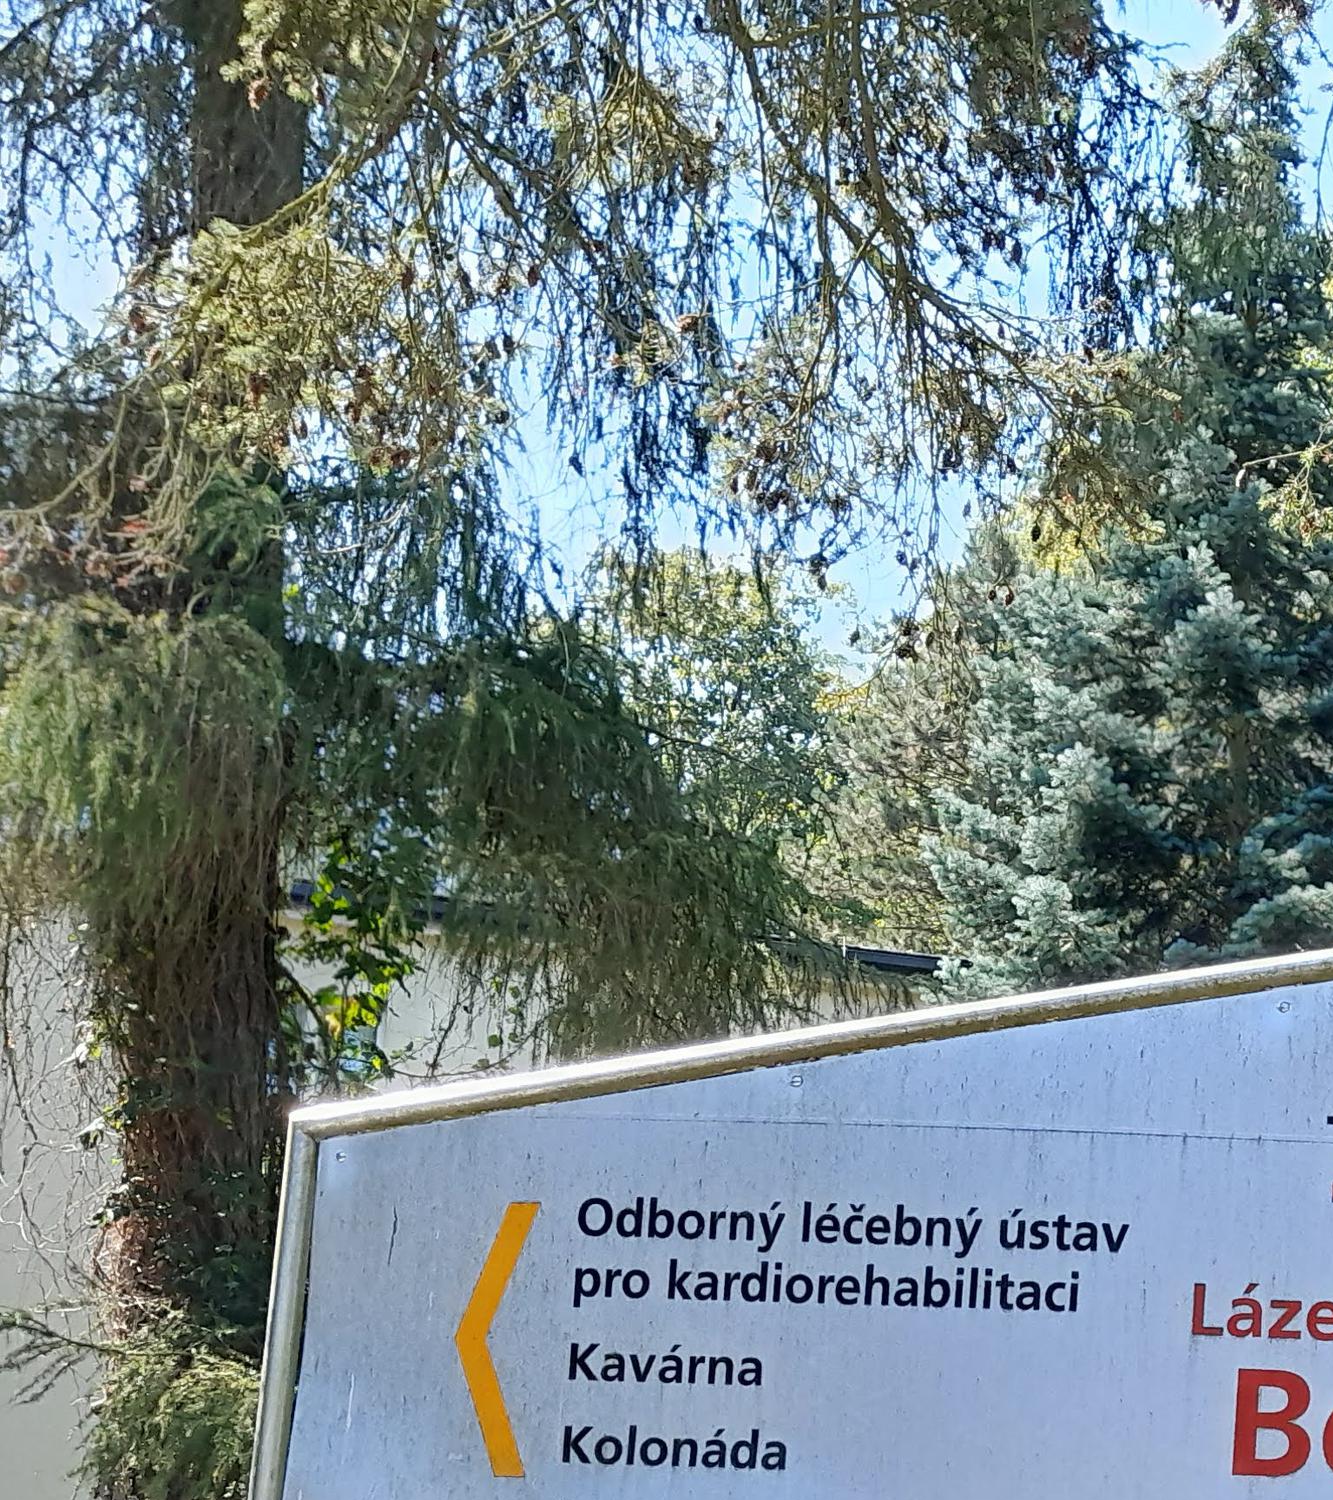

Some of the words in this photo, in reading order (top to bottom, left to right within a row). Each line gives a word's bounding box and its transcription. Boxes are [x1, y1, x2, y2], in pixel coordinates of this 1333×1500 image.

[577, 1196, 785, 1249] Odborný
[800, 1201, 981, 1257] léčebný
[998, 1206, 1131, 1254] ústav
[572, 1267, 651, 1307] pro
[666, 1258, 1080, 1313] kardiorehabilitaci
[567, 1342, 764, 1387] Kavárna
[561, 1424, 788, 1471] Kolonáda
